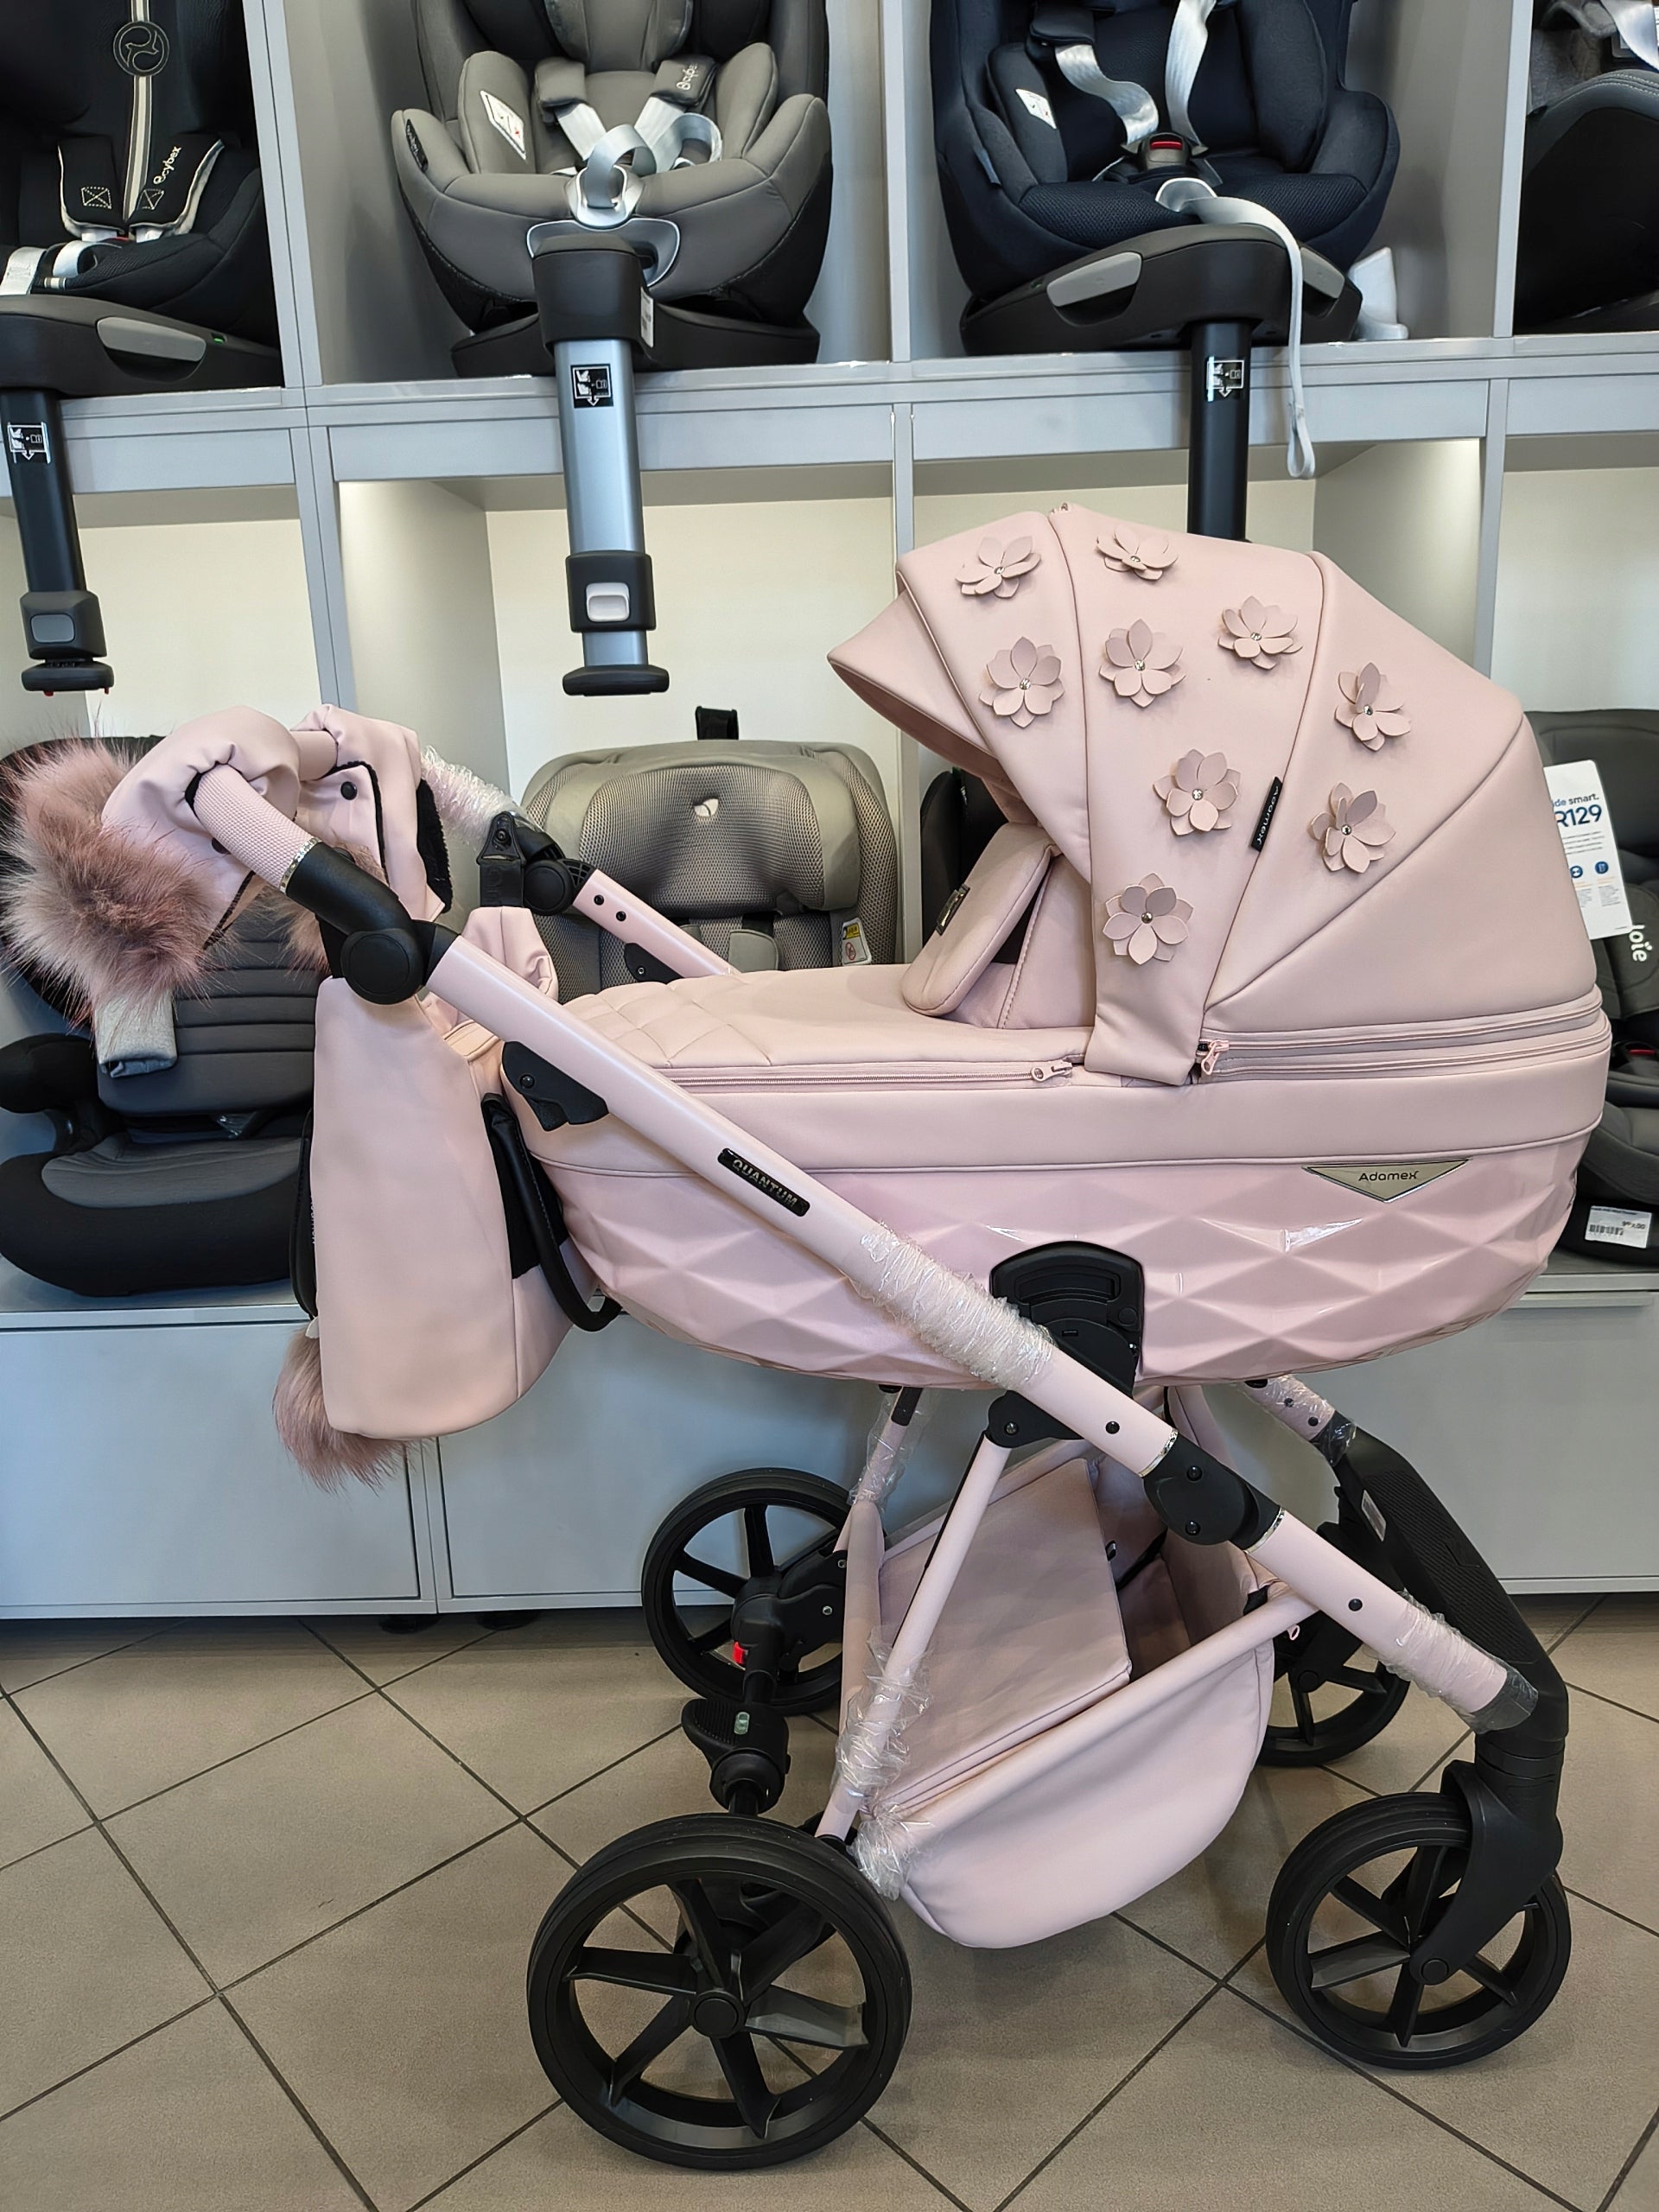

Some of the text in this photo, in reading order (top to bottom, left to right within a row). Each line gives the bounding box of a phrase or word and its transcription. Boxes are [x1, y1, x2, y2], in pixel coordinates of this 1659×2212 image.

[162, 146, 181, 177] cybex
[1568, 793, 1599, 805] smart.
[1554, 804, 1603, 828] R129
[732, 1159, 798, 1207] QUANTUM
[1358, 1170, 1420, 1181] Adamex
